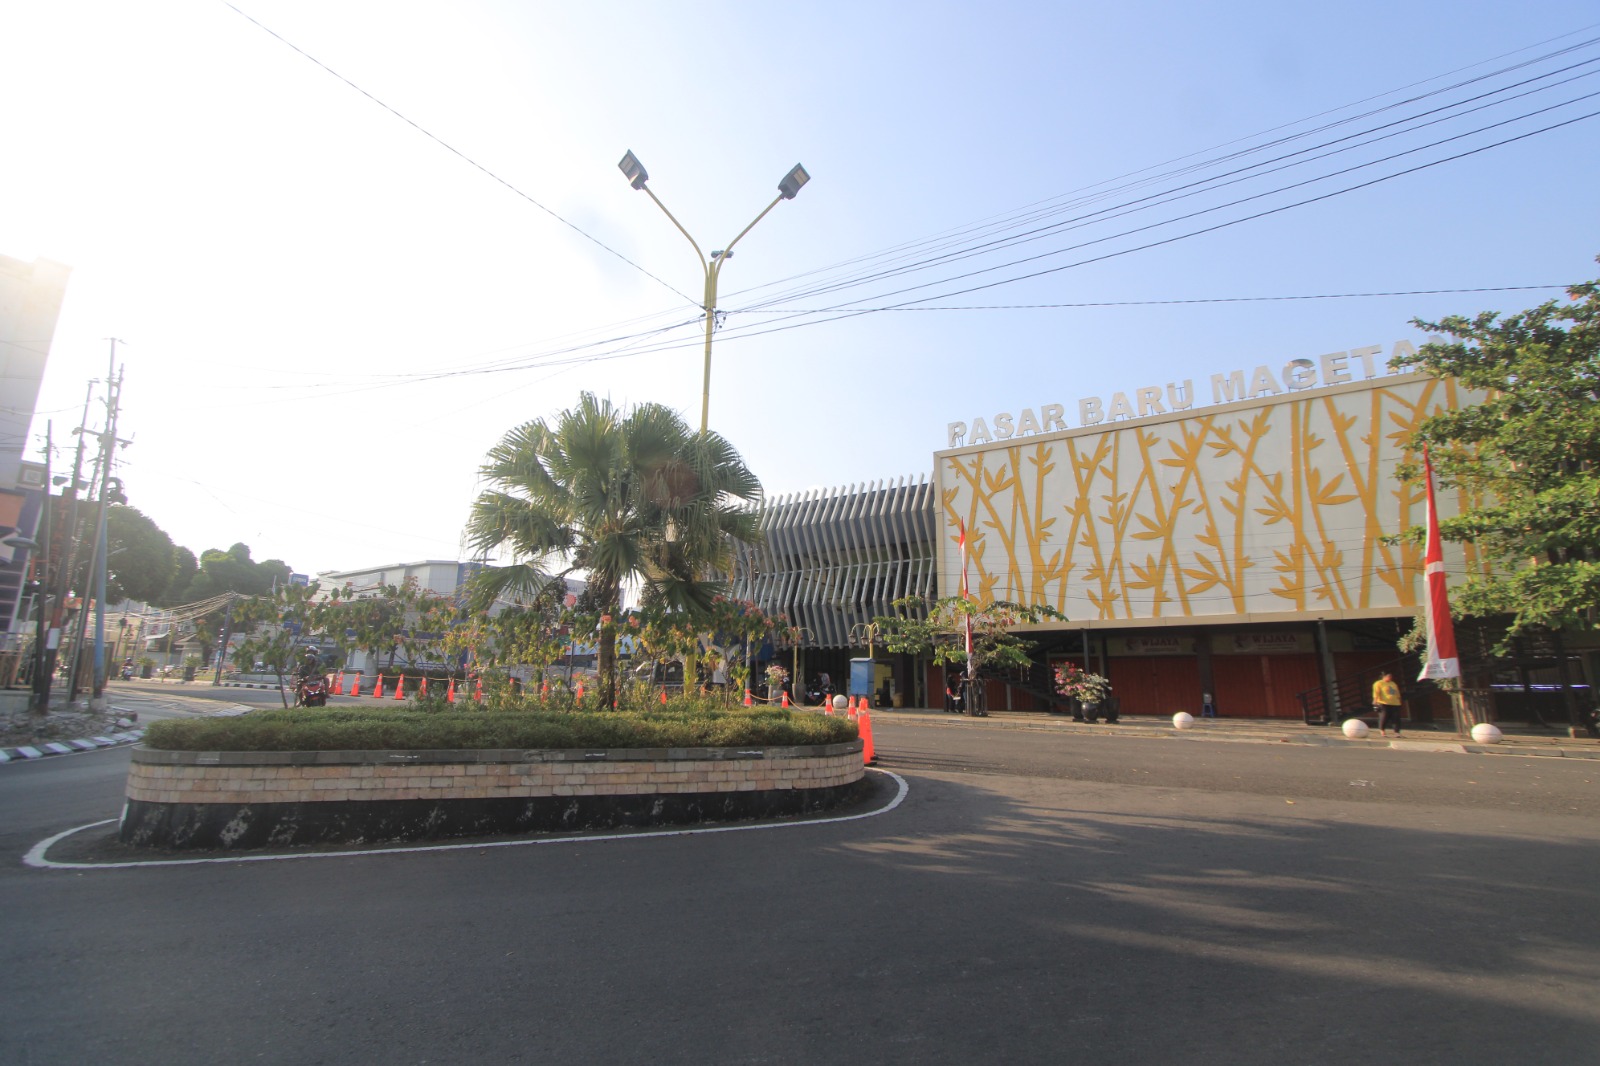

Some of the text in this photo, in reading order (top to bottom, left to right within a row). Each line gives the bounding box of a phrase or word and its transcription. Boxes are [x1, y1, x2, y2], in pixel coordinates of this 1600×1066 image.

[947, 403, 1068, 447] PASAR
[1079, 379, 1194, 425] BARU
[1141, 638, 1180, 647] WIJAYA
[1251, 634, 1297, 643] WIJAYA
